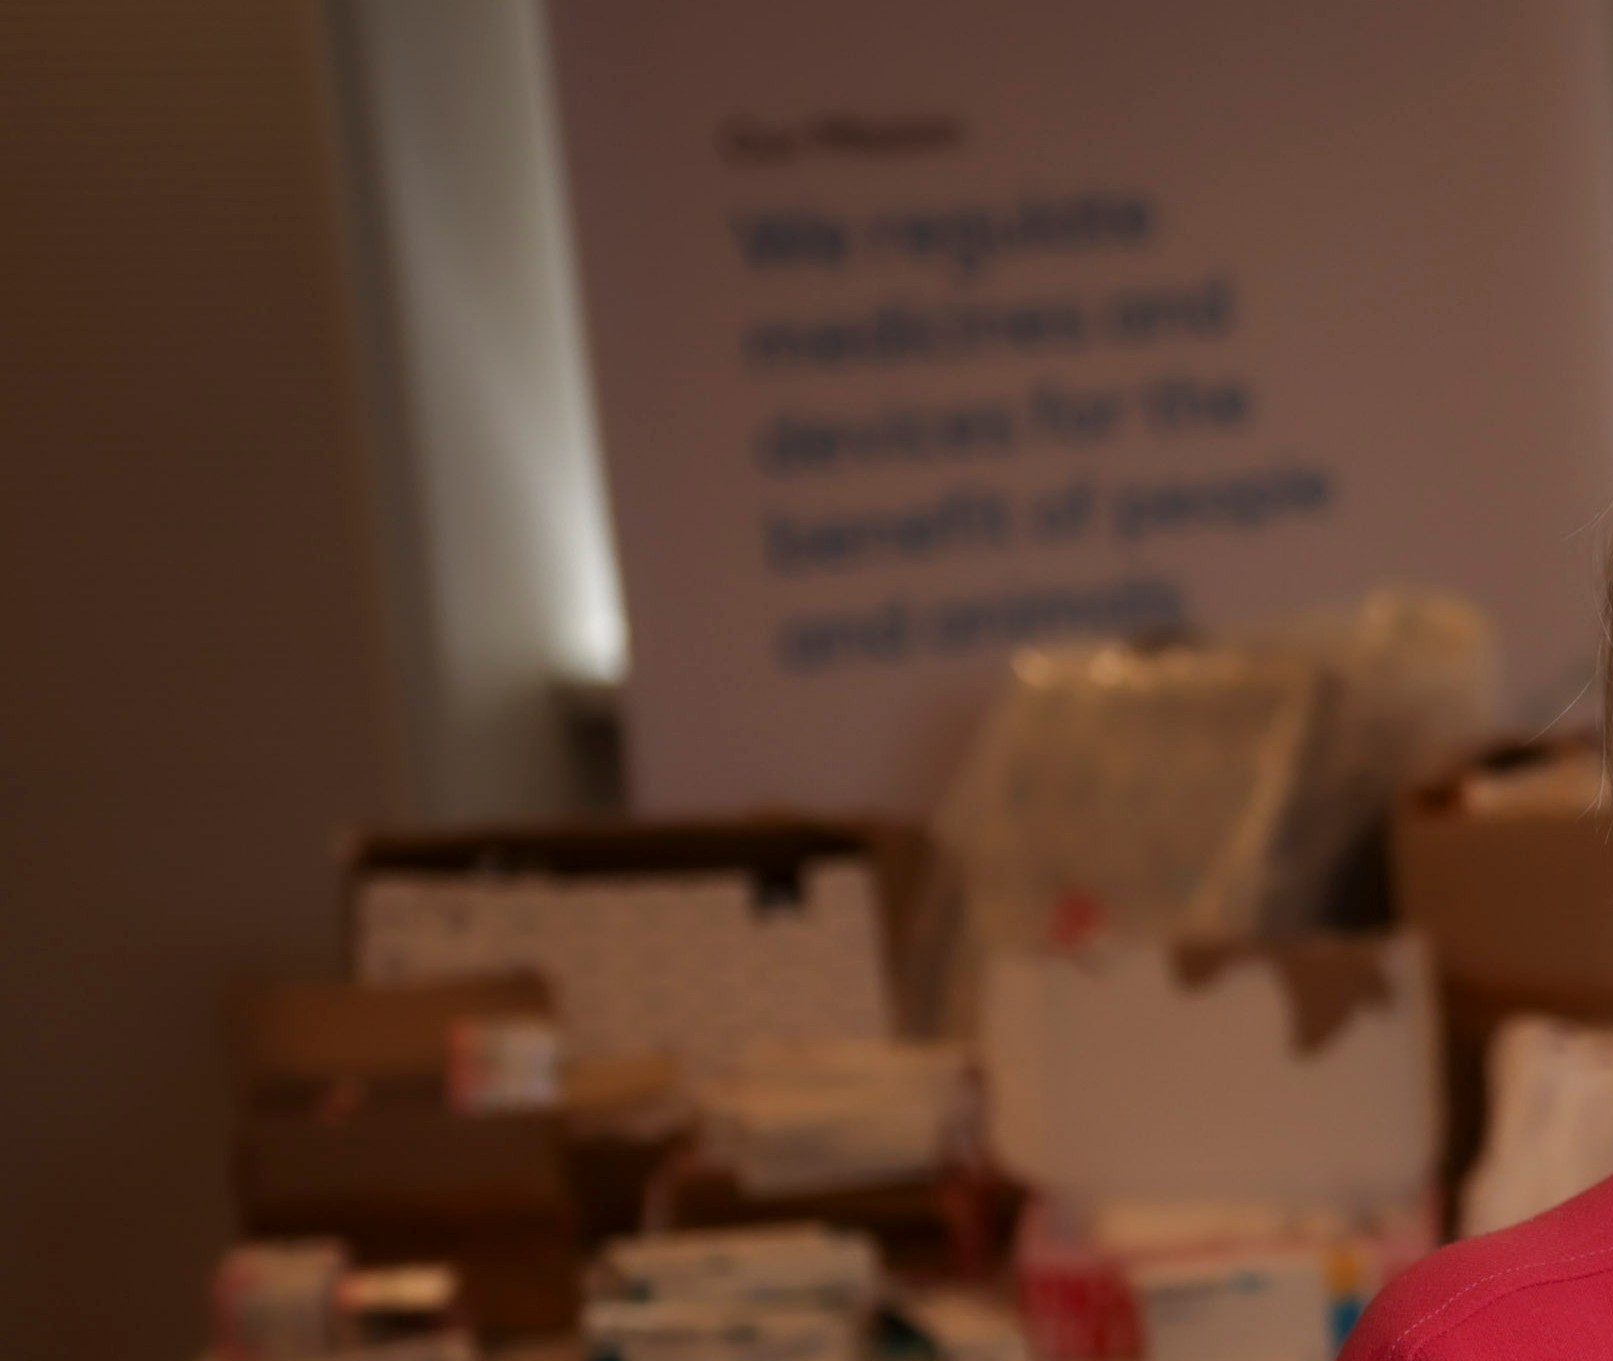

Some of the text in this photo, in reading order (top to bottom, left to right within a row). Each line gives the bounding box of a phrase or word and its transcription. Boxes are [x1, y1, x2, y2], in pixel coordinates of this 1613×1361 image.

[731, 188, 1160, 278] We regulate
[741, 277, 1238, 372] medicines and
[756, 372, 1255, 475] devices for the
[764, 465, 1332, 574] benefit of people
[776, 597, 913, 674] and
